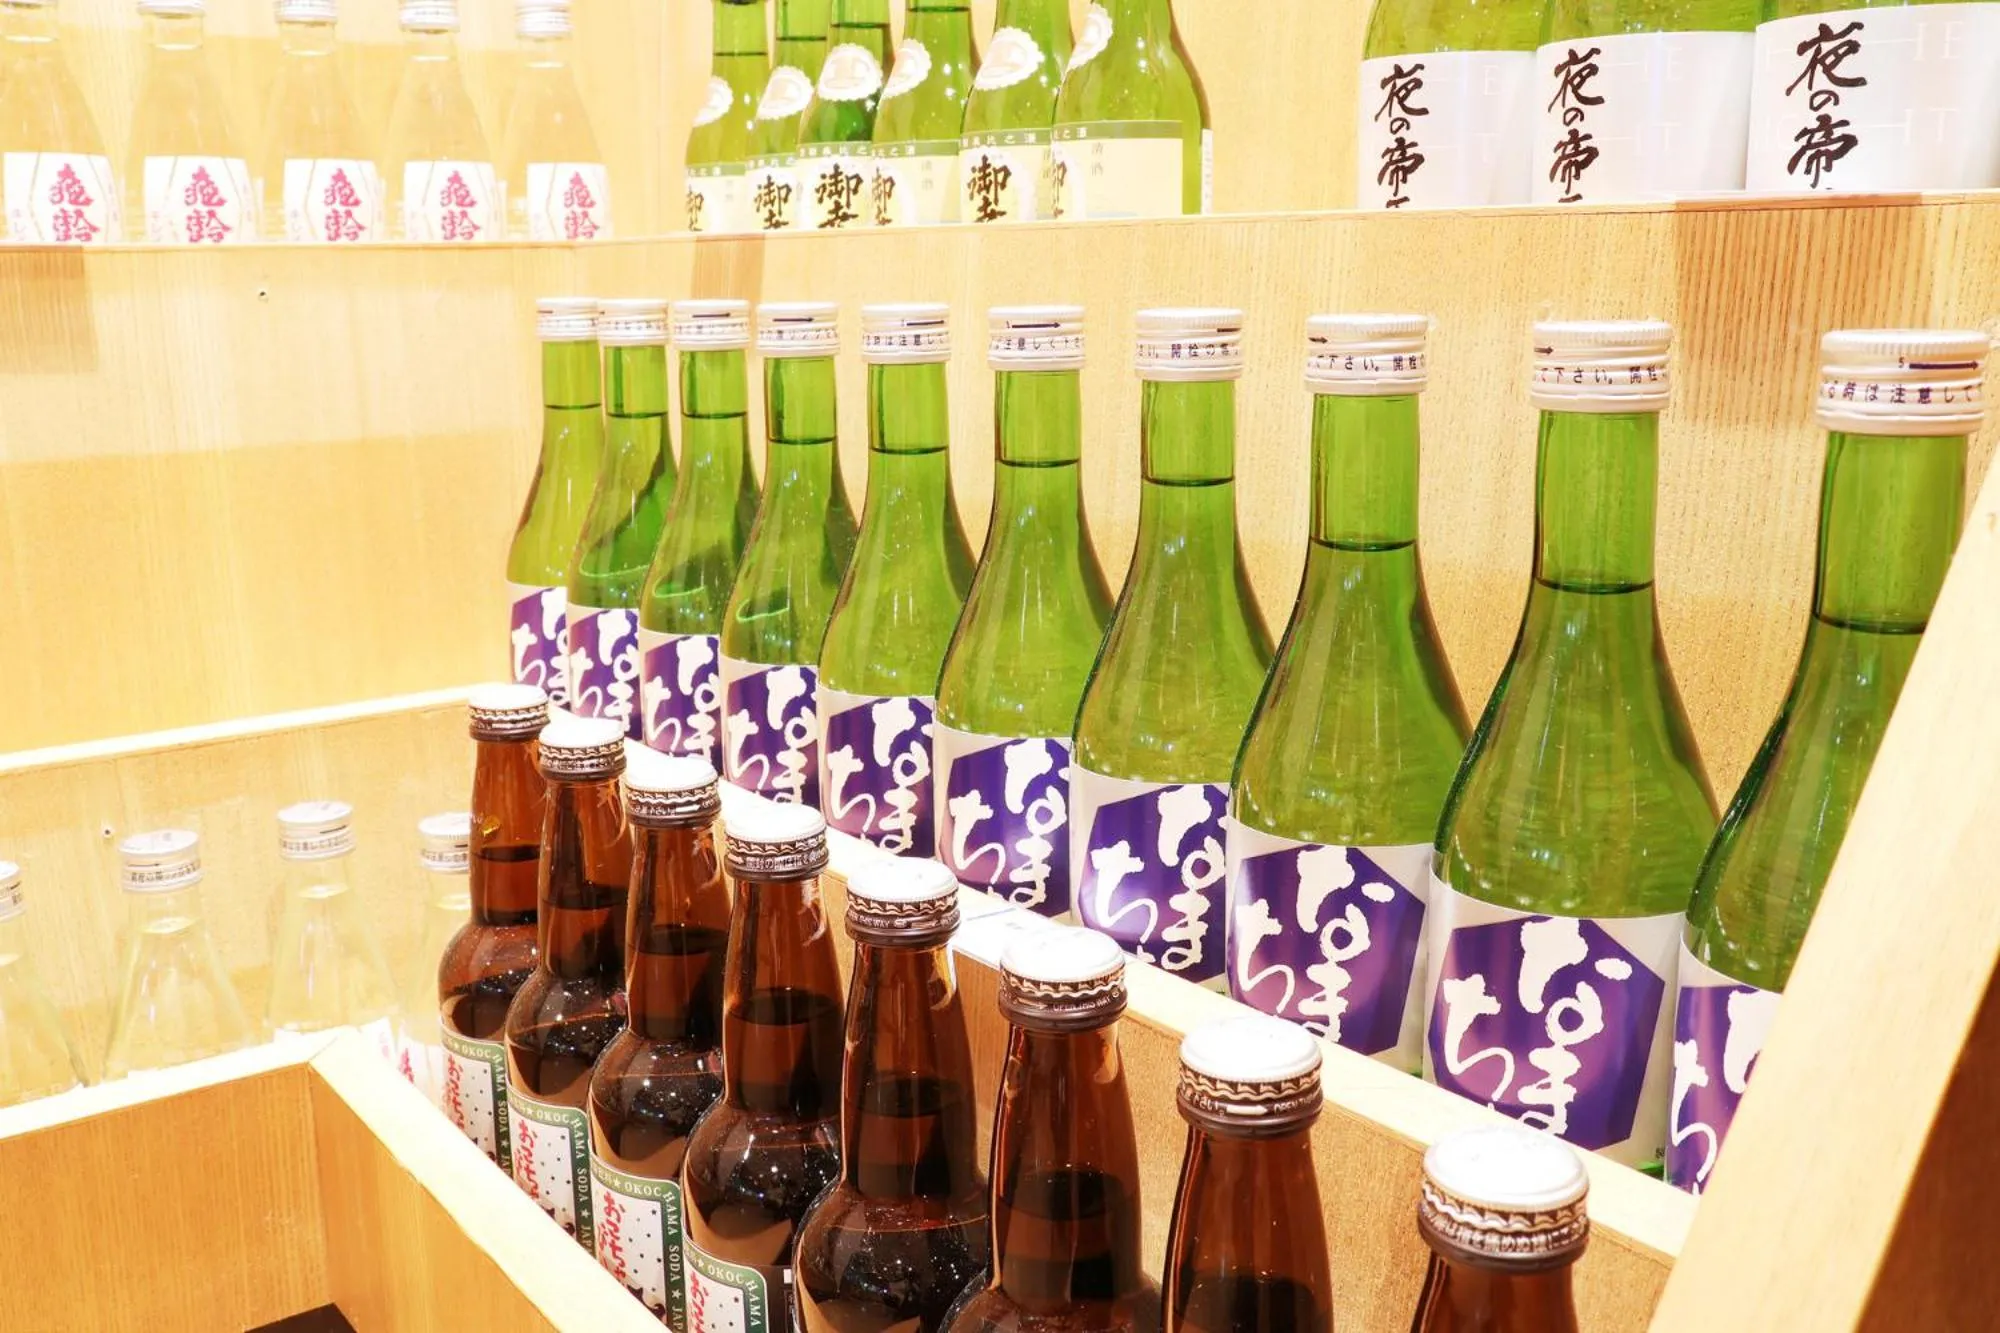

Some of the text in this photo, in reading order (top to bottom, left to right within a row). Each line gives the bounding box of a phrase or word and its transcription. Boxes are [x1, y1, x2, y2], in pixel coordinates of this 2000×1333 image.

[1548, 48, 1606, 203] 夜の帝
[1785, 21, 1868, 190] 夜の帝
[577, 1167, 589, 1202] SODA
[623, 1183, 676, 1236] OKOCHAMA
[668, 1245, 681, 1282] SODA
